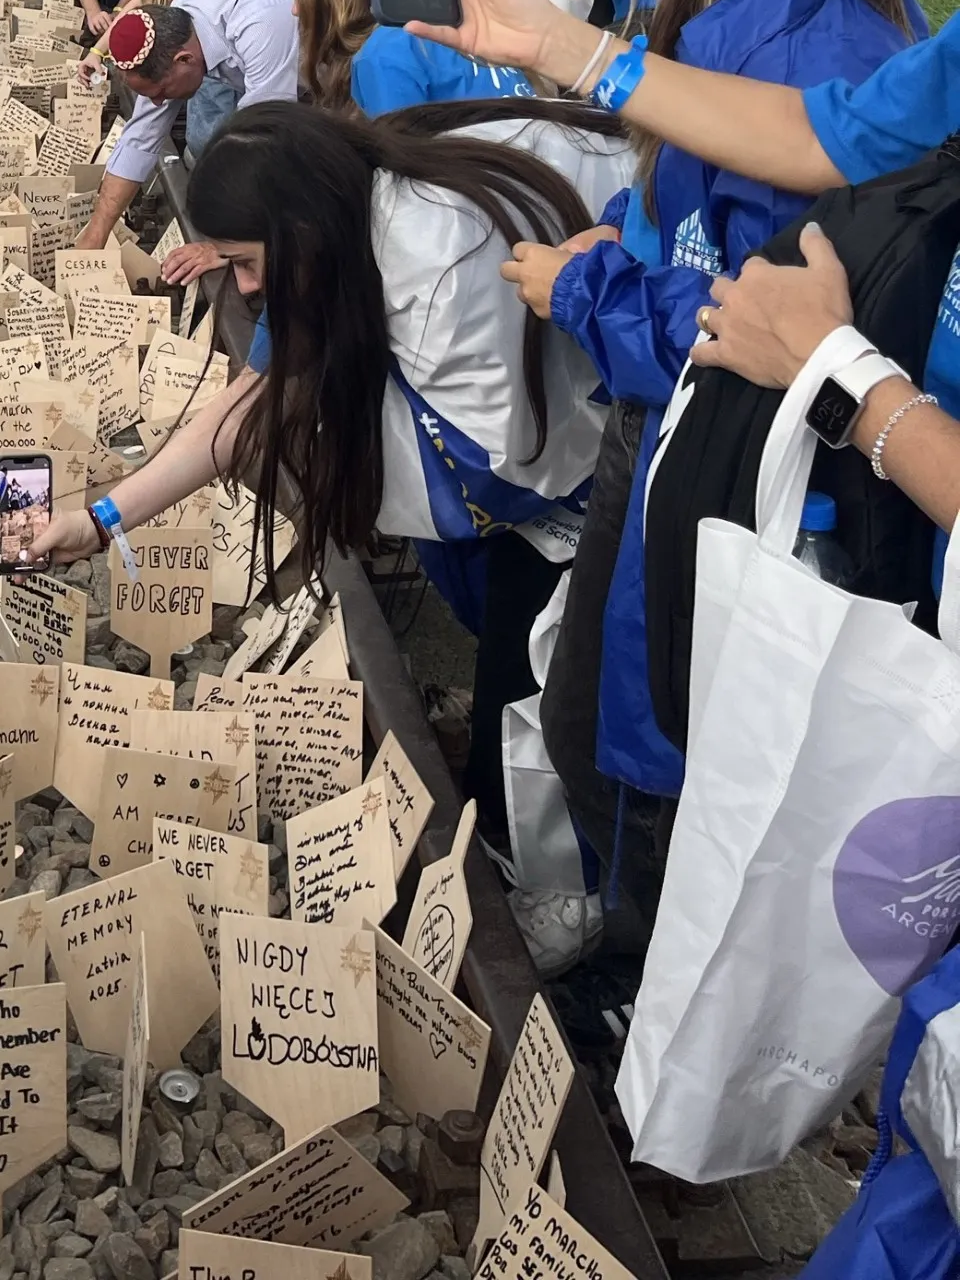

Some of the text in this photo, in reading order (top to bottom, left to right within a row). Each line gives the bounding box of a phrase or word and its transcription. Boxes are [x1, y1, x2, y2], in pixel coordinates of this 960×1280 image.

[24, 192, 62, 203] NEVER
[65, 260, 108, 269] CESARE
[1, 403, 33, 416] March
[13, 421, 32, 432] the
[12, 591, 74, 623] David Berger
[116, 581, 204, 615] FORGET
[5, 613, 62, 647] and ALL the
[12, 629, 64, 658] 6,000,000
[113, 805, 139, 821] AM
[158, 827, 228, 855] WE NEVER
[60, 887, 138, 928] ETERNAL
[66, 914, 133, 952] MEMORY
[86, 951, 132, 979] Latvia
[236, 938, 308, 976] NIGDY
[251, 983, 336, 1019] WIĘCEJ
[0, 1062, 32, 1081] Are
[18, 1088, 41, 1105] To
[524, 1188, 541, 1219] YO
[499, 1231, 518, 1256] LOS
[491, 1245, 508, 1273] POR
